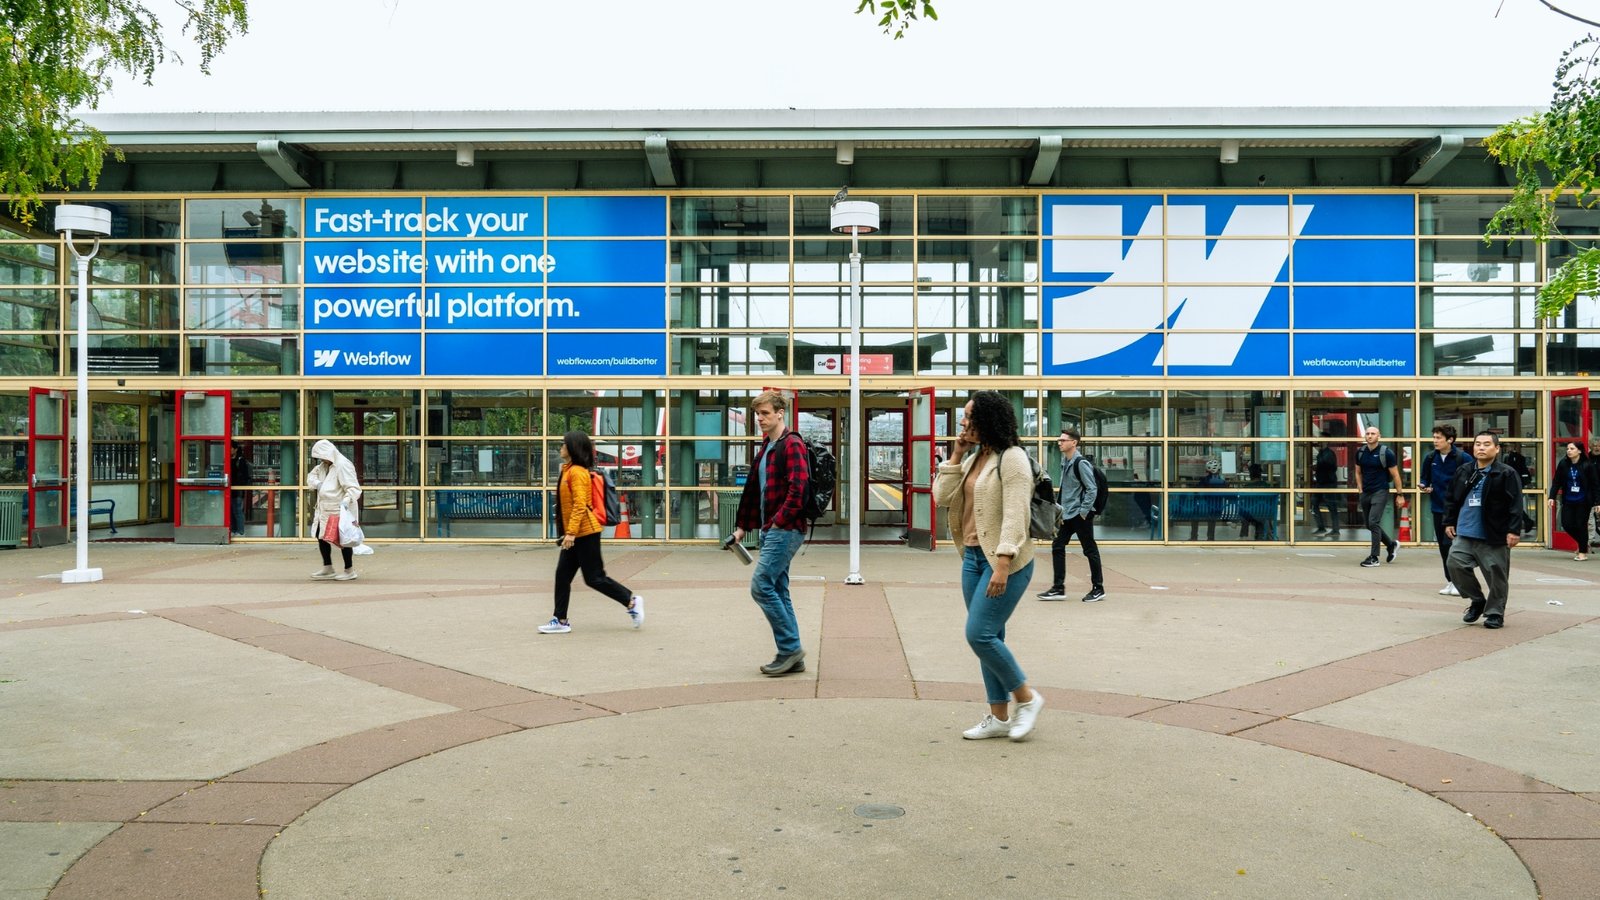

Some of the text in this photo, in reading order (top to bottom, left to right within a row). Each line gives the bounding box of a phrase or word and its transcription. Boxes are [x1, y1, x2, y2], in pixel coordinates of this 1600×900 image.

[315, 208, 529, 238] Fast-track your
[314, 248, 556, 274] website with one
[314, 292, 580, 324] powerful platform.
[343, 351, 411, 366] Webflow
[556, 357, 658, 367] webflow.com/buildbetter
[1302, 358, 1406, 368] webflow.com/buildbetter
